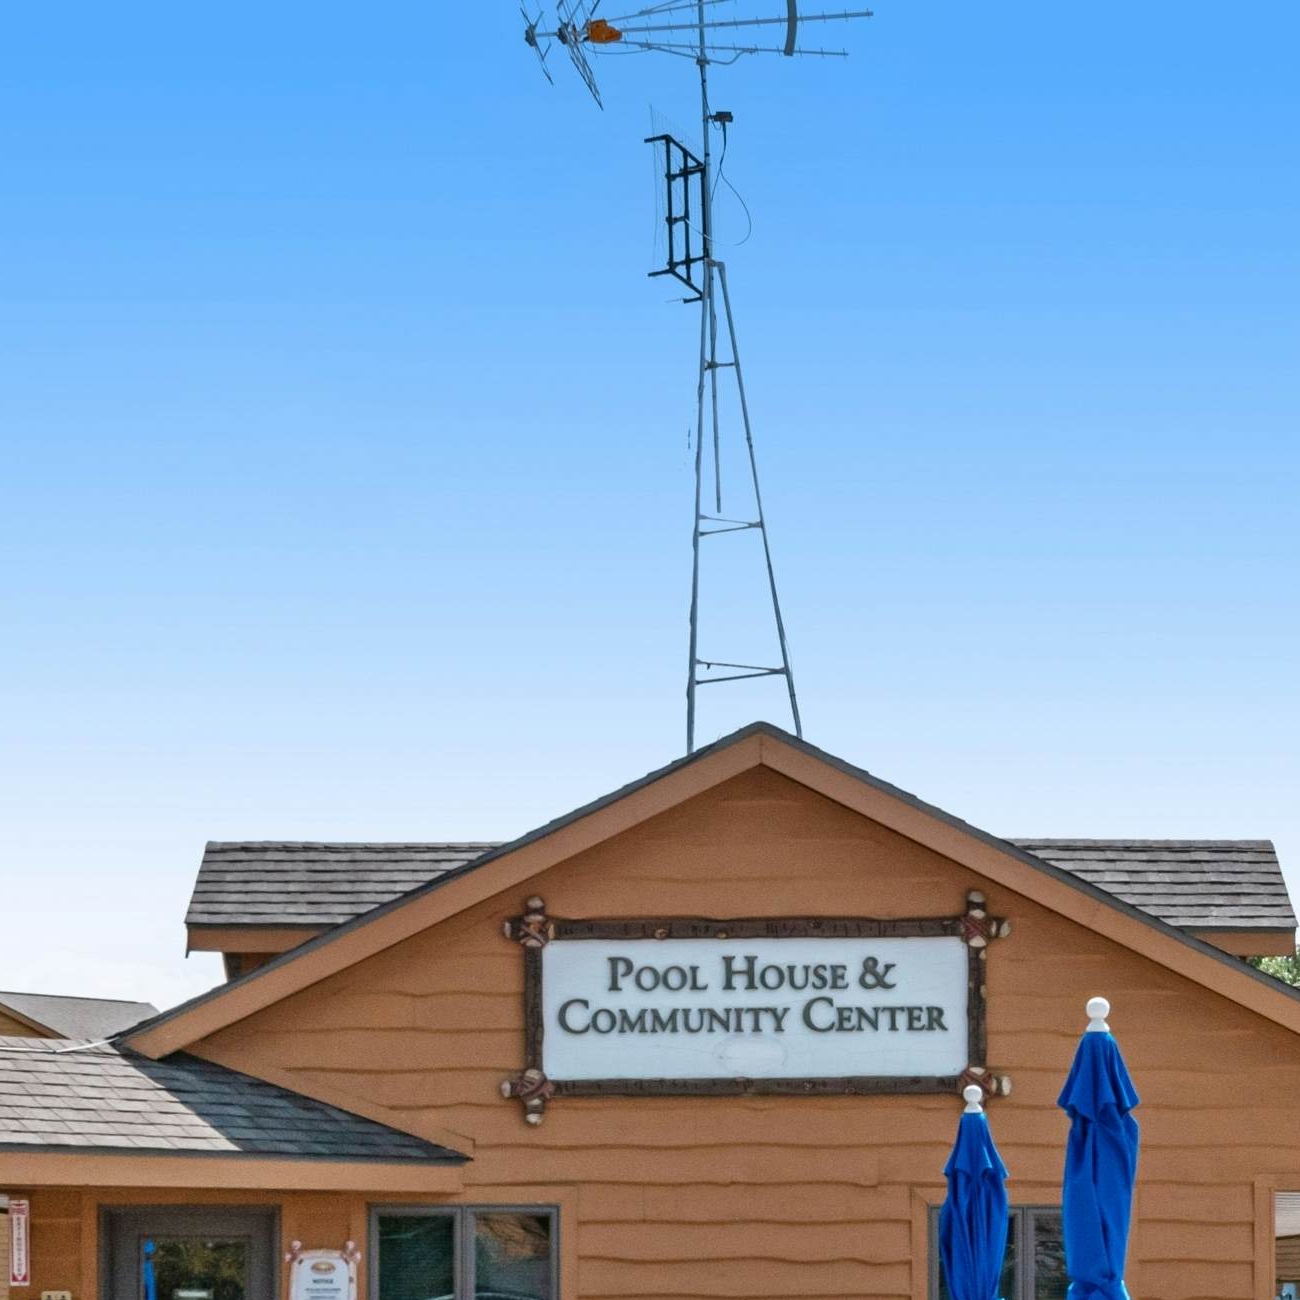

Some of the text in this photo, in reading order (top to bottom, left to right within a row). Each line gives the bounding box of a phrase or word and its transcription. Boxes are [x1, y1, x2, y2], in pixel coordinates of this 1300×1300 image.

[607, 955, 897, 992] POOL HOUSE &
[557, 996, 948, 1035] COMMUNITY CENTER
